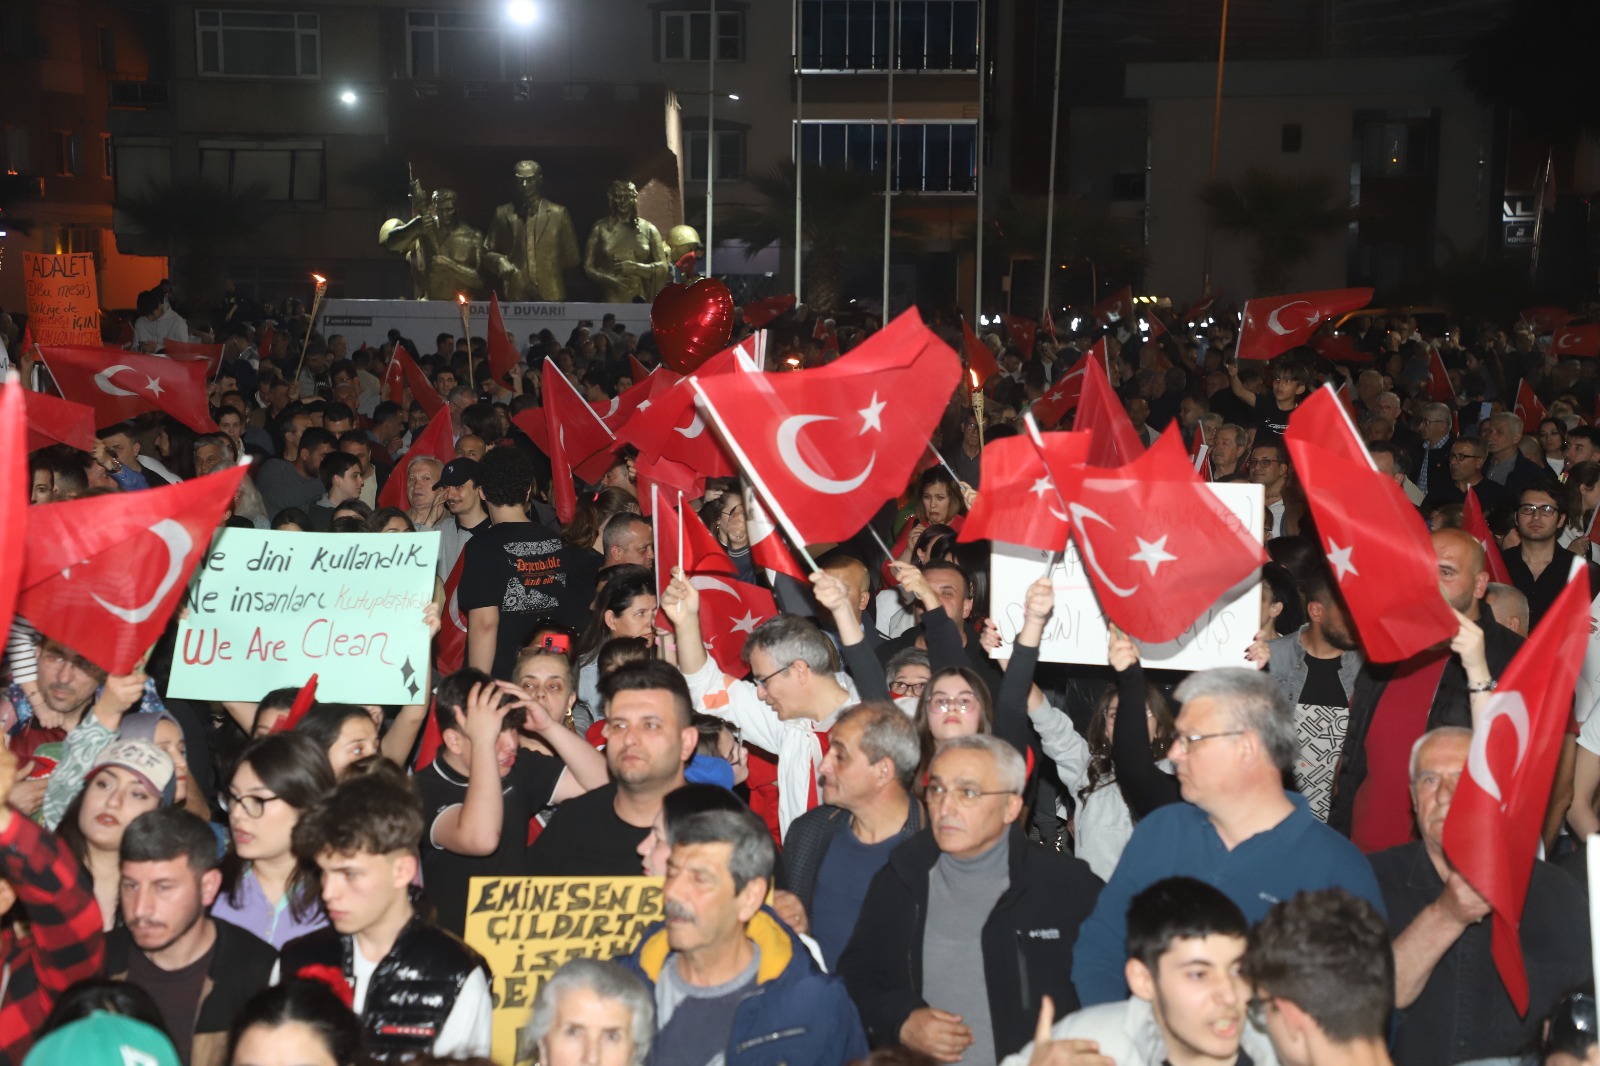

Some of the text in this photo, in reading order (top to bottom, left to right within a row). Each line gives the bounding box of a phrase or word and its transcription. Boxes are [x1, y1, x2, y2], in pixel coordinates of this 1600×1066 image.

[57, 281, 91, 298] mesaj
[513, 305, 566, 316] DUVARI!
[246, 541, 294, 573] dini
[183, 618, 396, 666] We Are Clean
